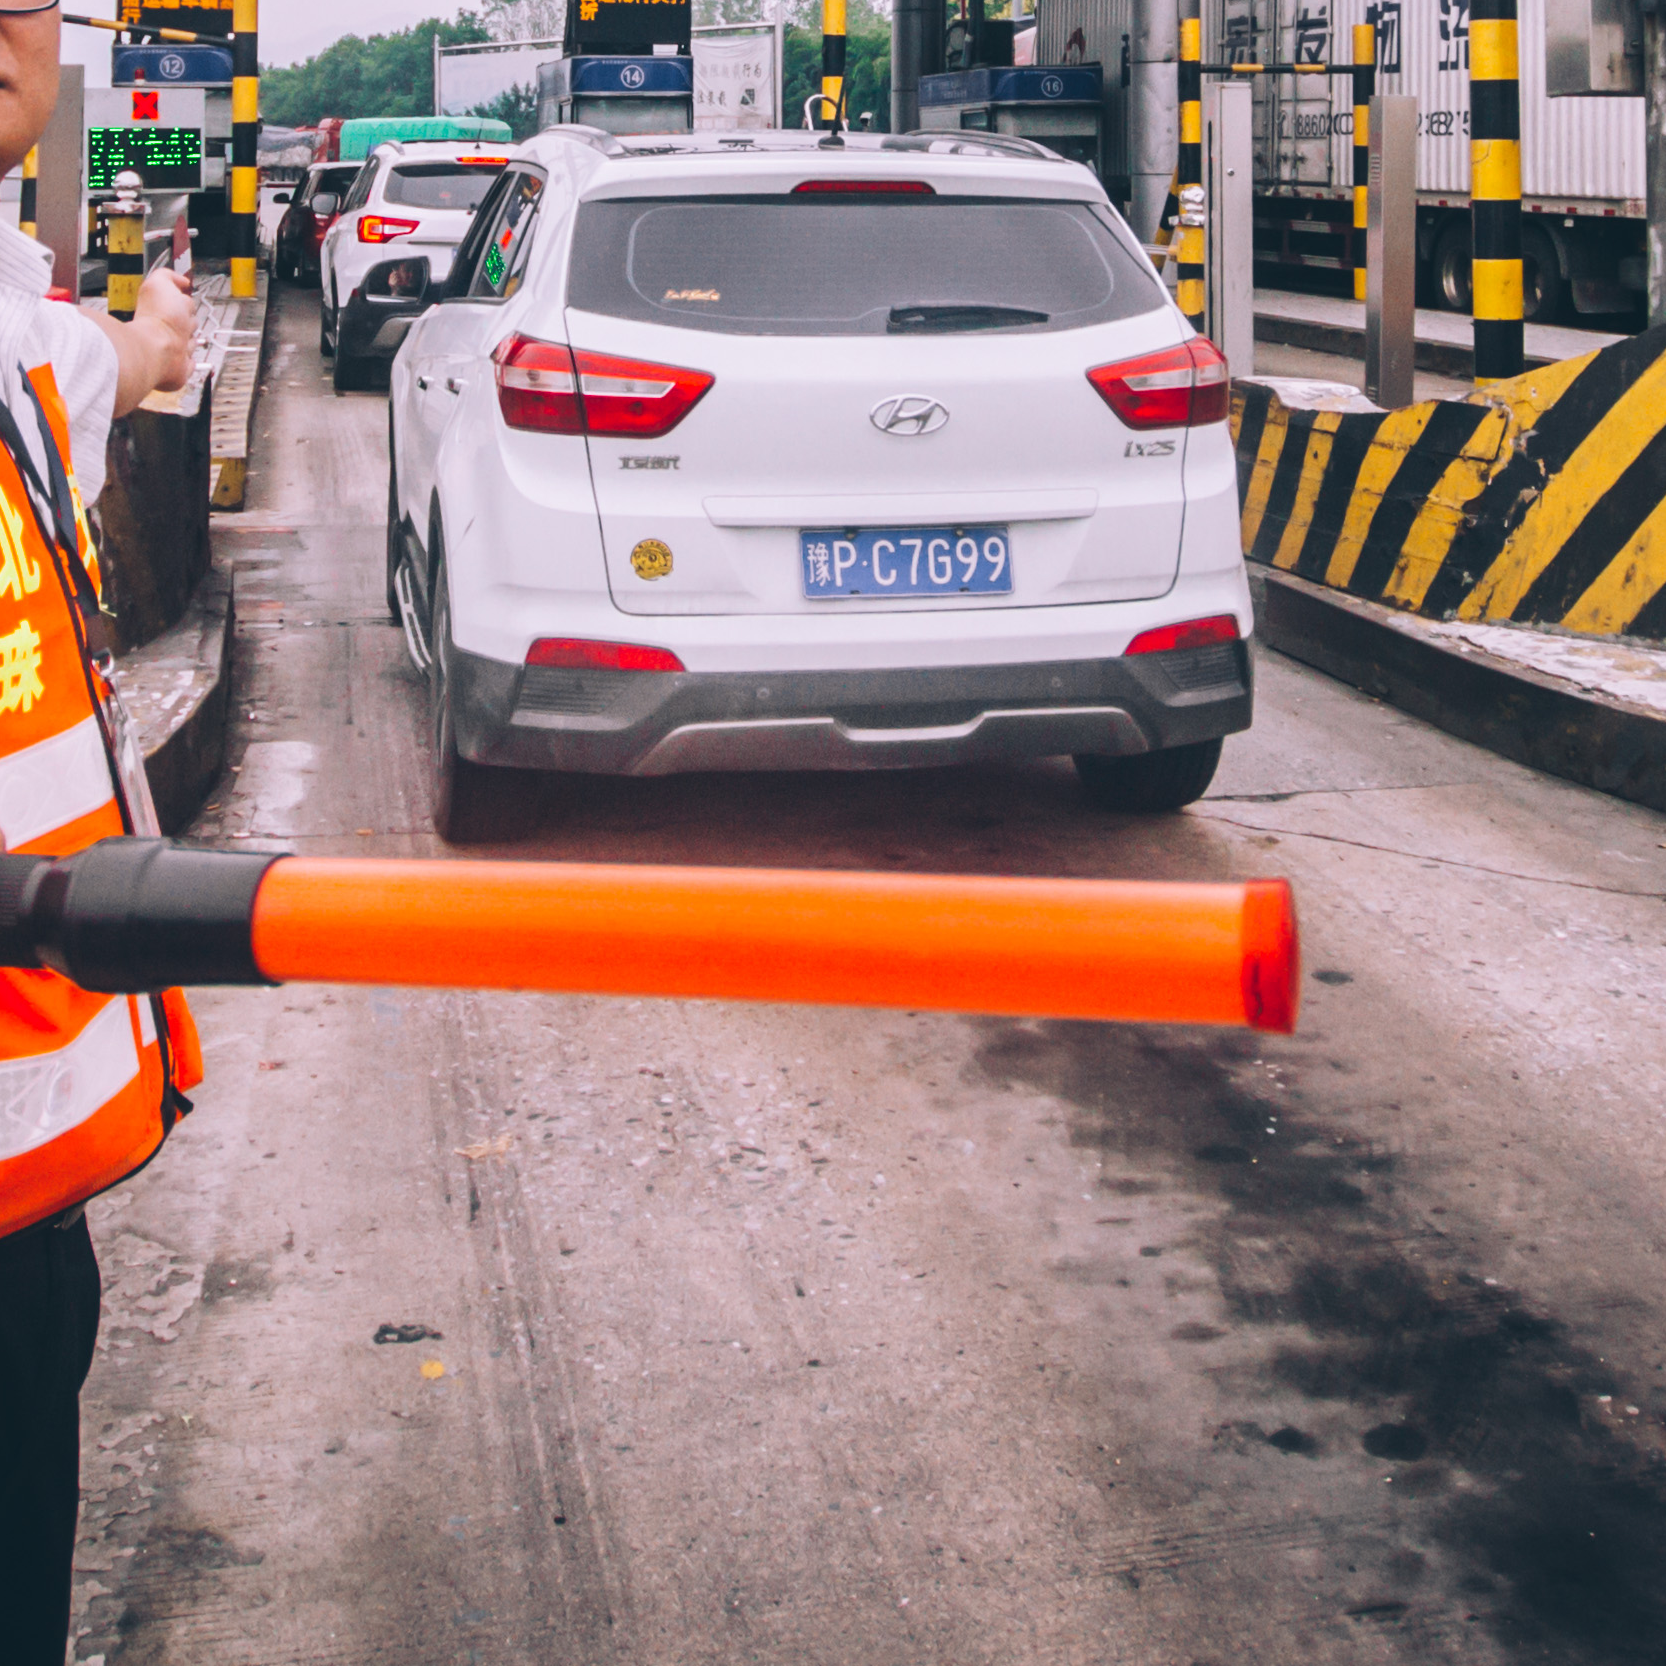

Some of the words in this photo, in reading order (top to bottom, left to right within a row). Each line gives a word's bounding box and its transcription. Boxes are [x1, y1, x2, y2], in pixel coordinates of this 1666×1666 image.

[163, 59, 181, 75] 12
[623, 70, 641, 83] 14
[1044, 80, 1060, 93] 16
